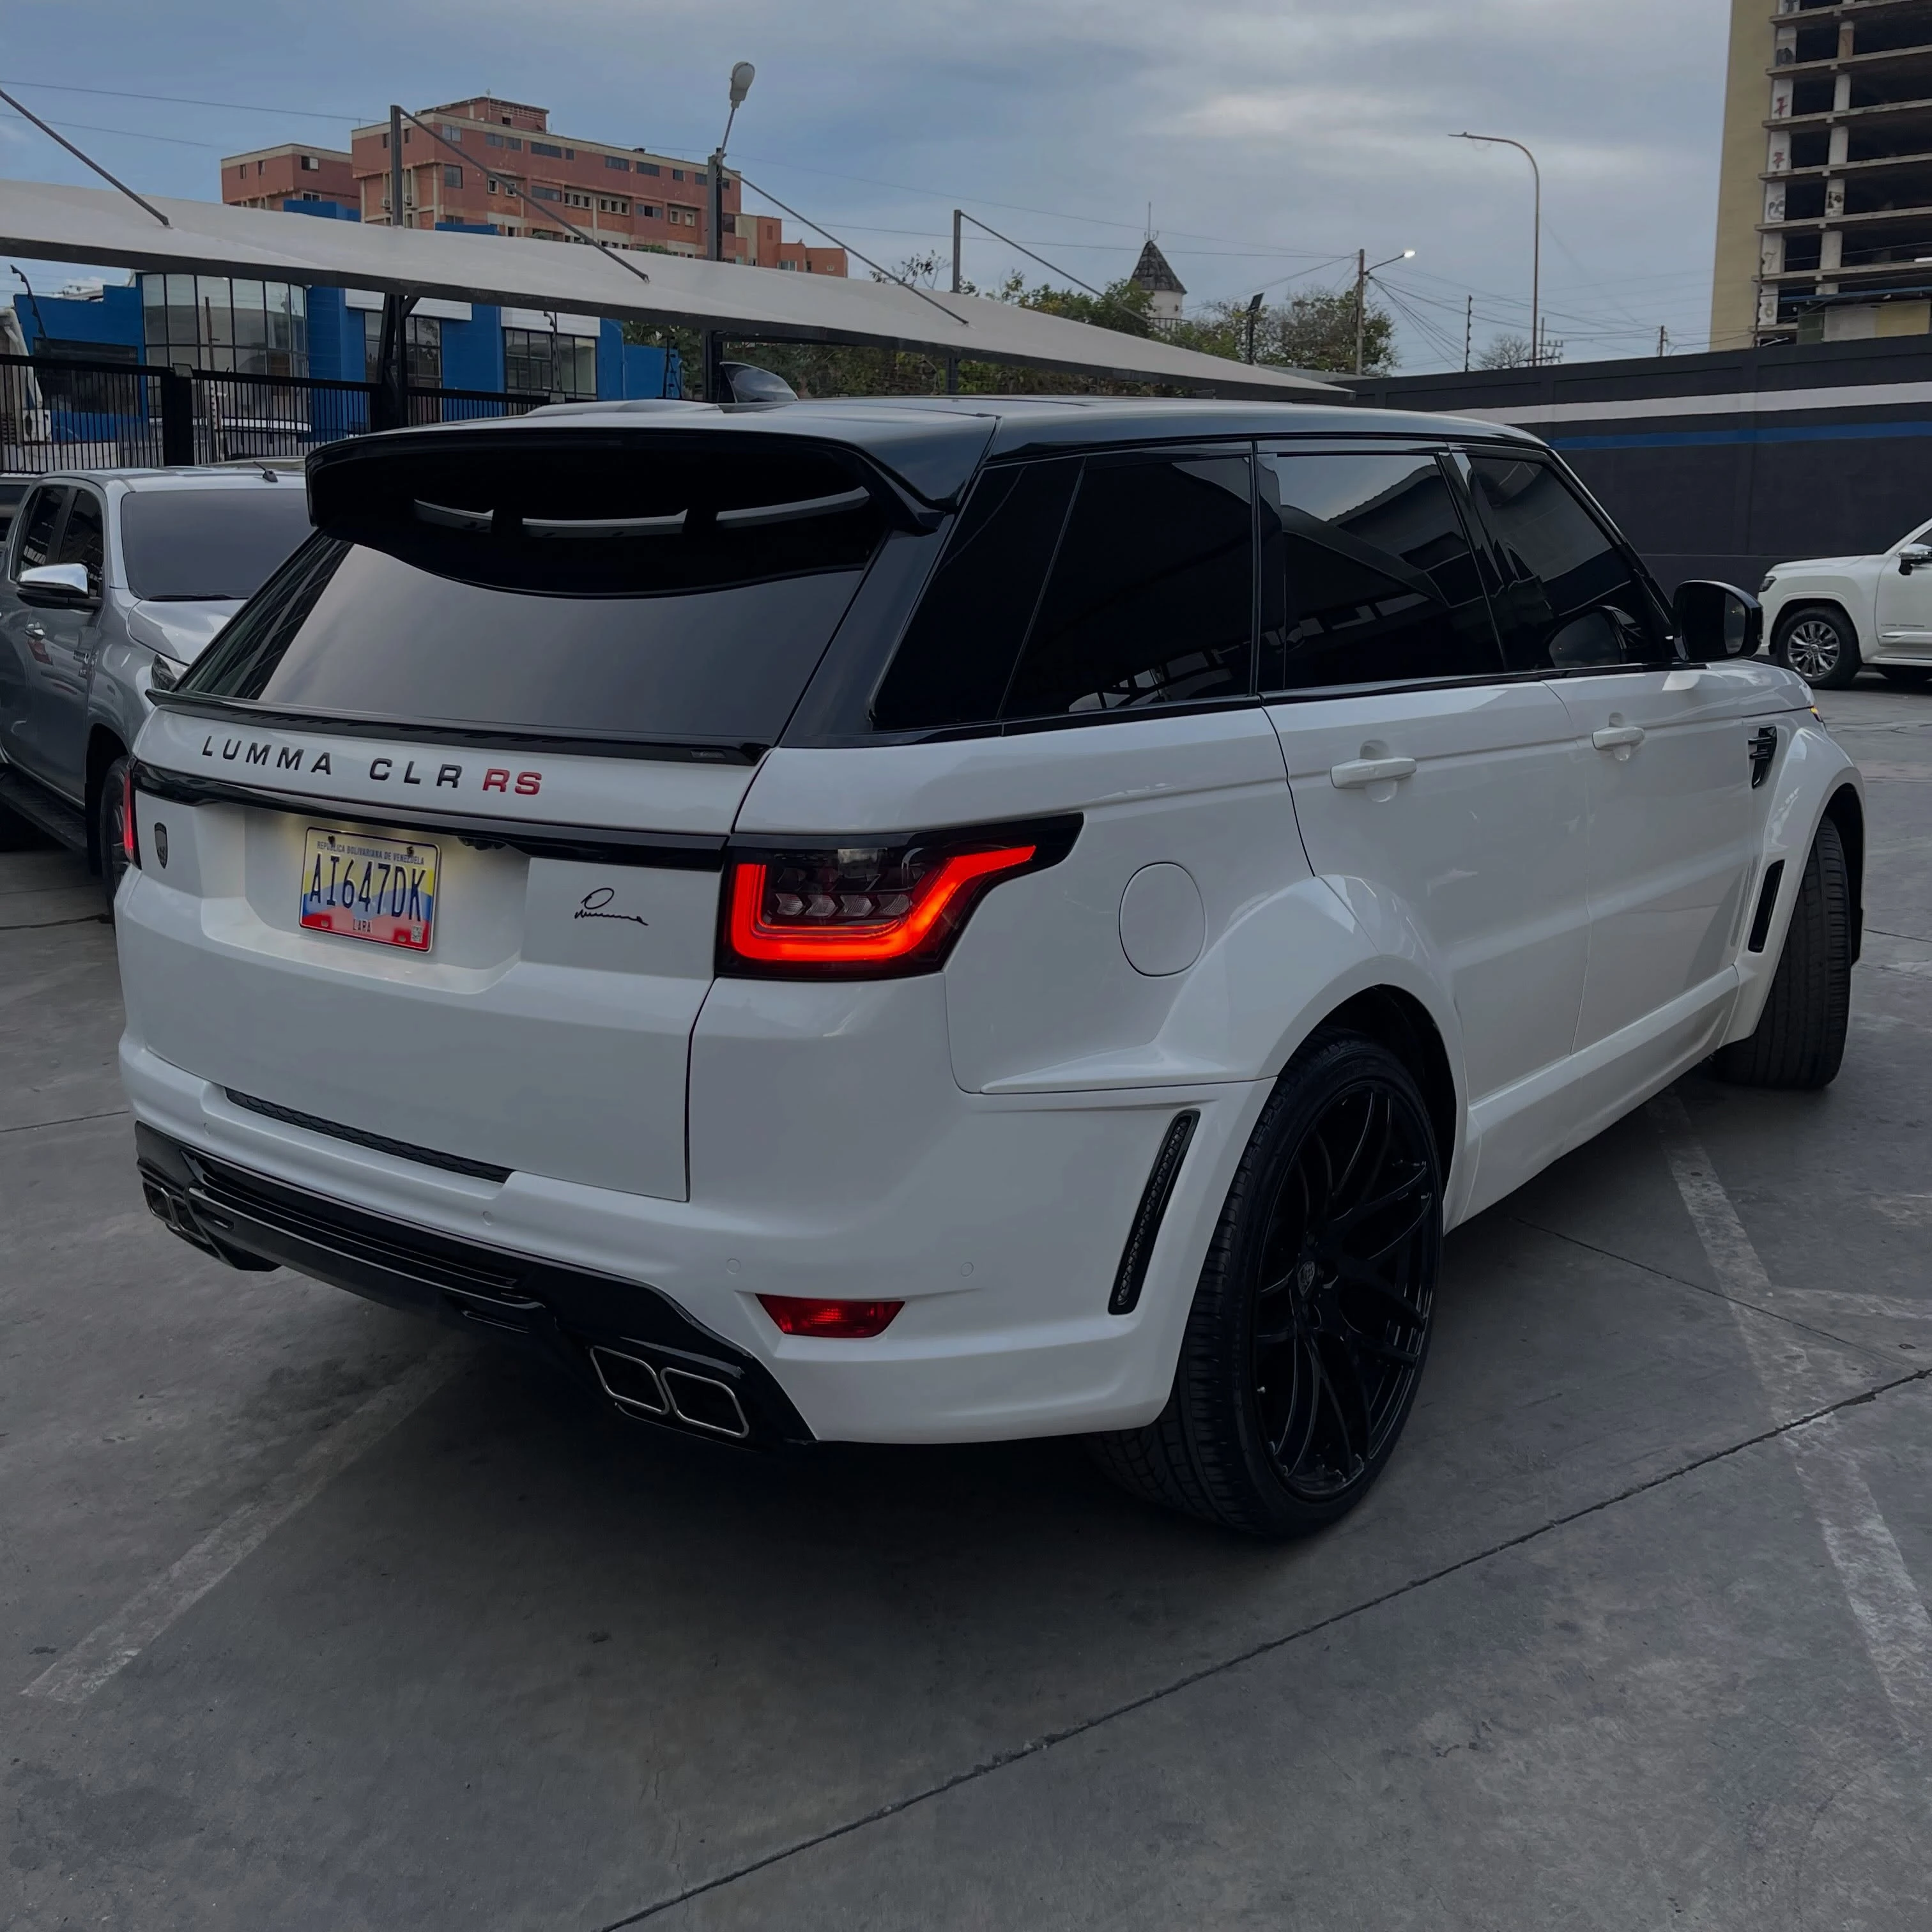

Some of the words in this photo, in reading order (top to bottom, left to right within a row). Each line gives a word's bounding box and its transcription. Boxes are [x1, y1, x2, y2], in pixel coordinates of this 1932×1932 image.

[202, 735, 332, 775] LUMMA
[369, 758, 463, 788] CLR
[482, 769, 542, 795] RS
[384, 851, 392, 860] DE
[309, 853, 426, 922] AI647DK
[353, 919, 371, 933] LARA
